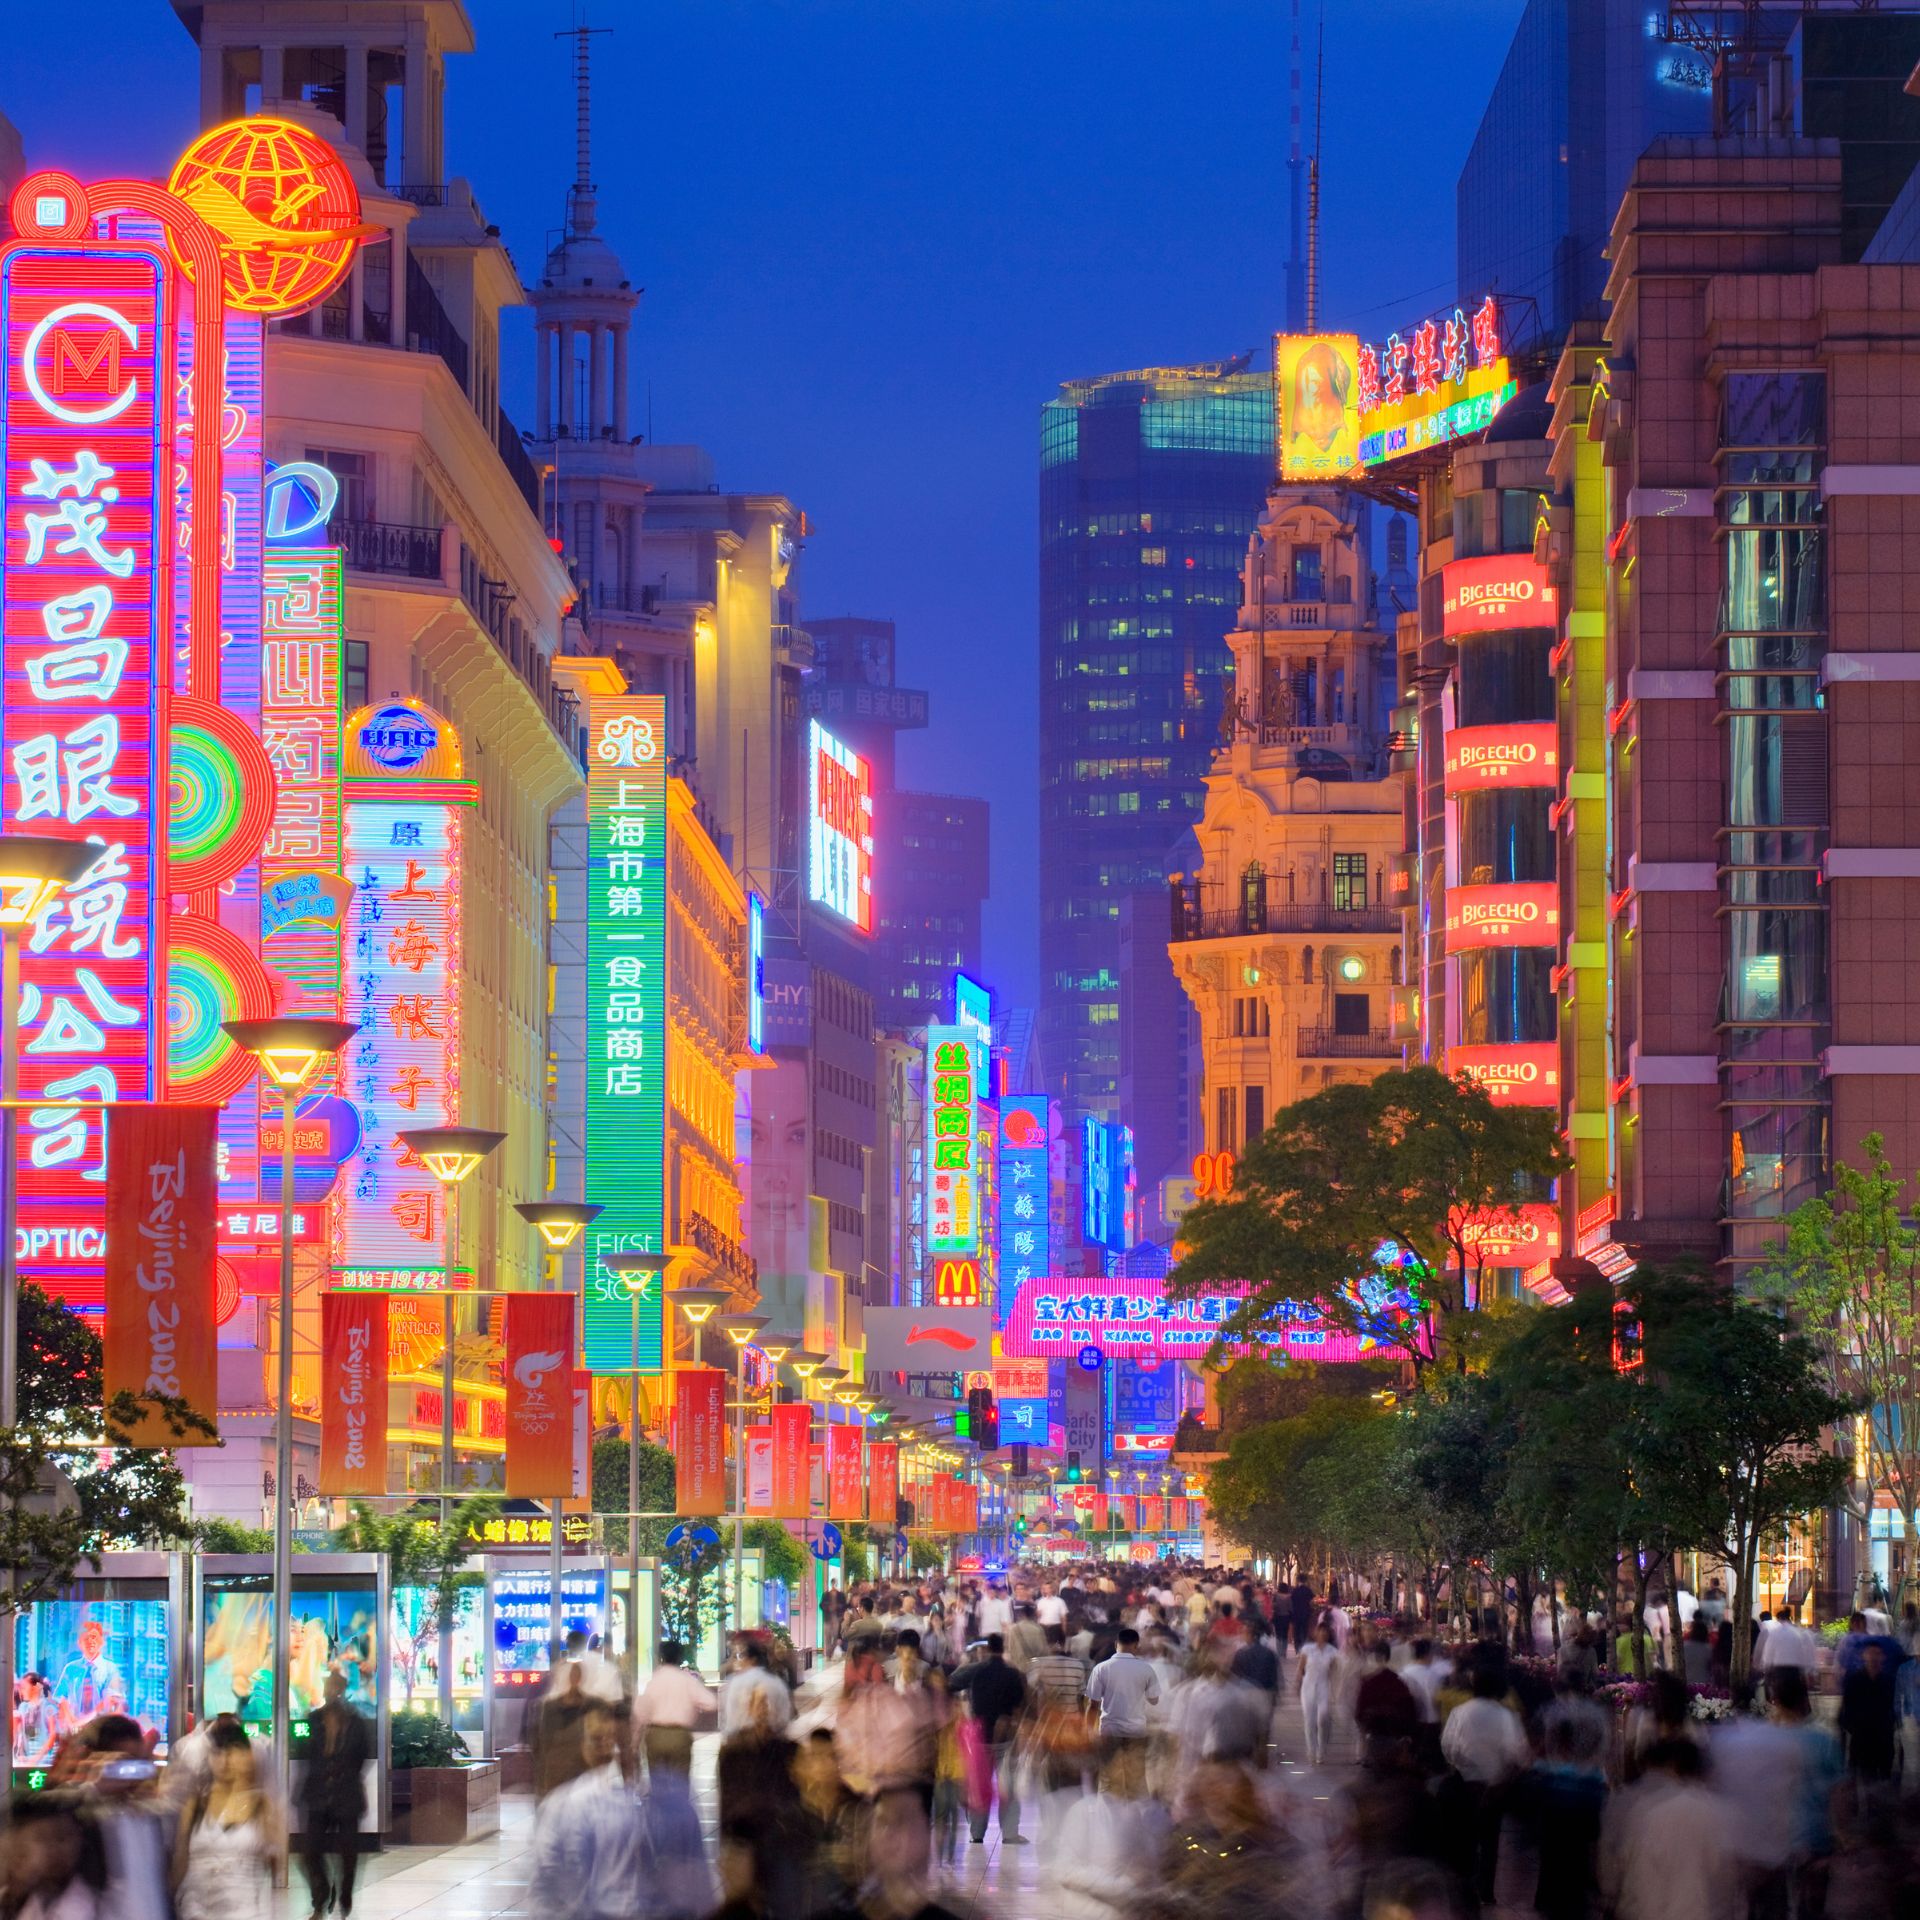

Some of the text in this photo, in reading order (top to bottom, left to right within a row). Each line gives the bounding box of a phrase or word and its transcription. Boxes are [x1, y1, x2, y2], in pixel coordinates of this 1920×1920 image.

[605, 778, 646, 1097] 上海市第一食品商店
[136, 1147, 185, 1400] Beijing 2008
[340, 1318, 371, 1470] Beijing 2008
[1031, 1327, 1064, 1341] BAO
[1070, 1329, 1094, 1343] DA
[1103, 1329, 1154, 1344] XIANG
[1289, 1330, 1328, 1346] KIDS
[694, 1413, 705, 1500] Share the Dream
[1147, 1437, 1168, 1448] KFC
